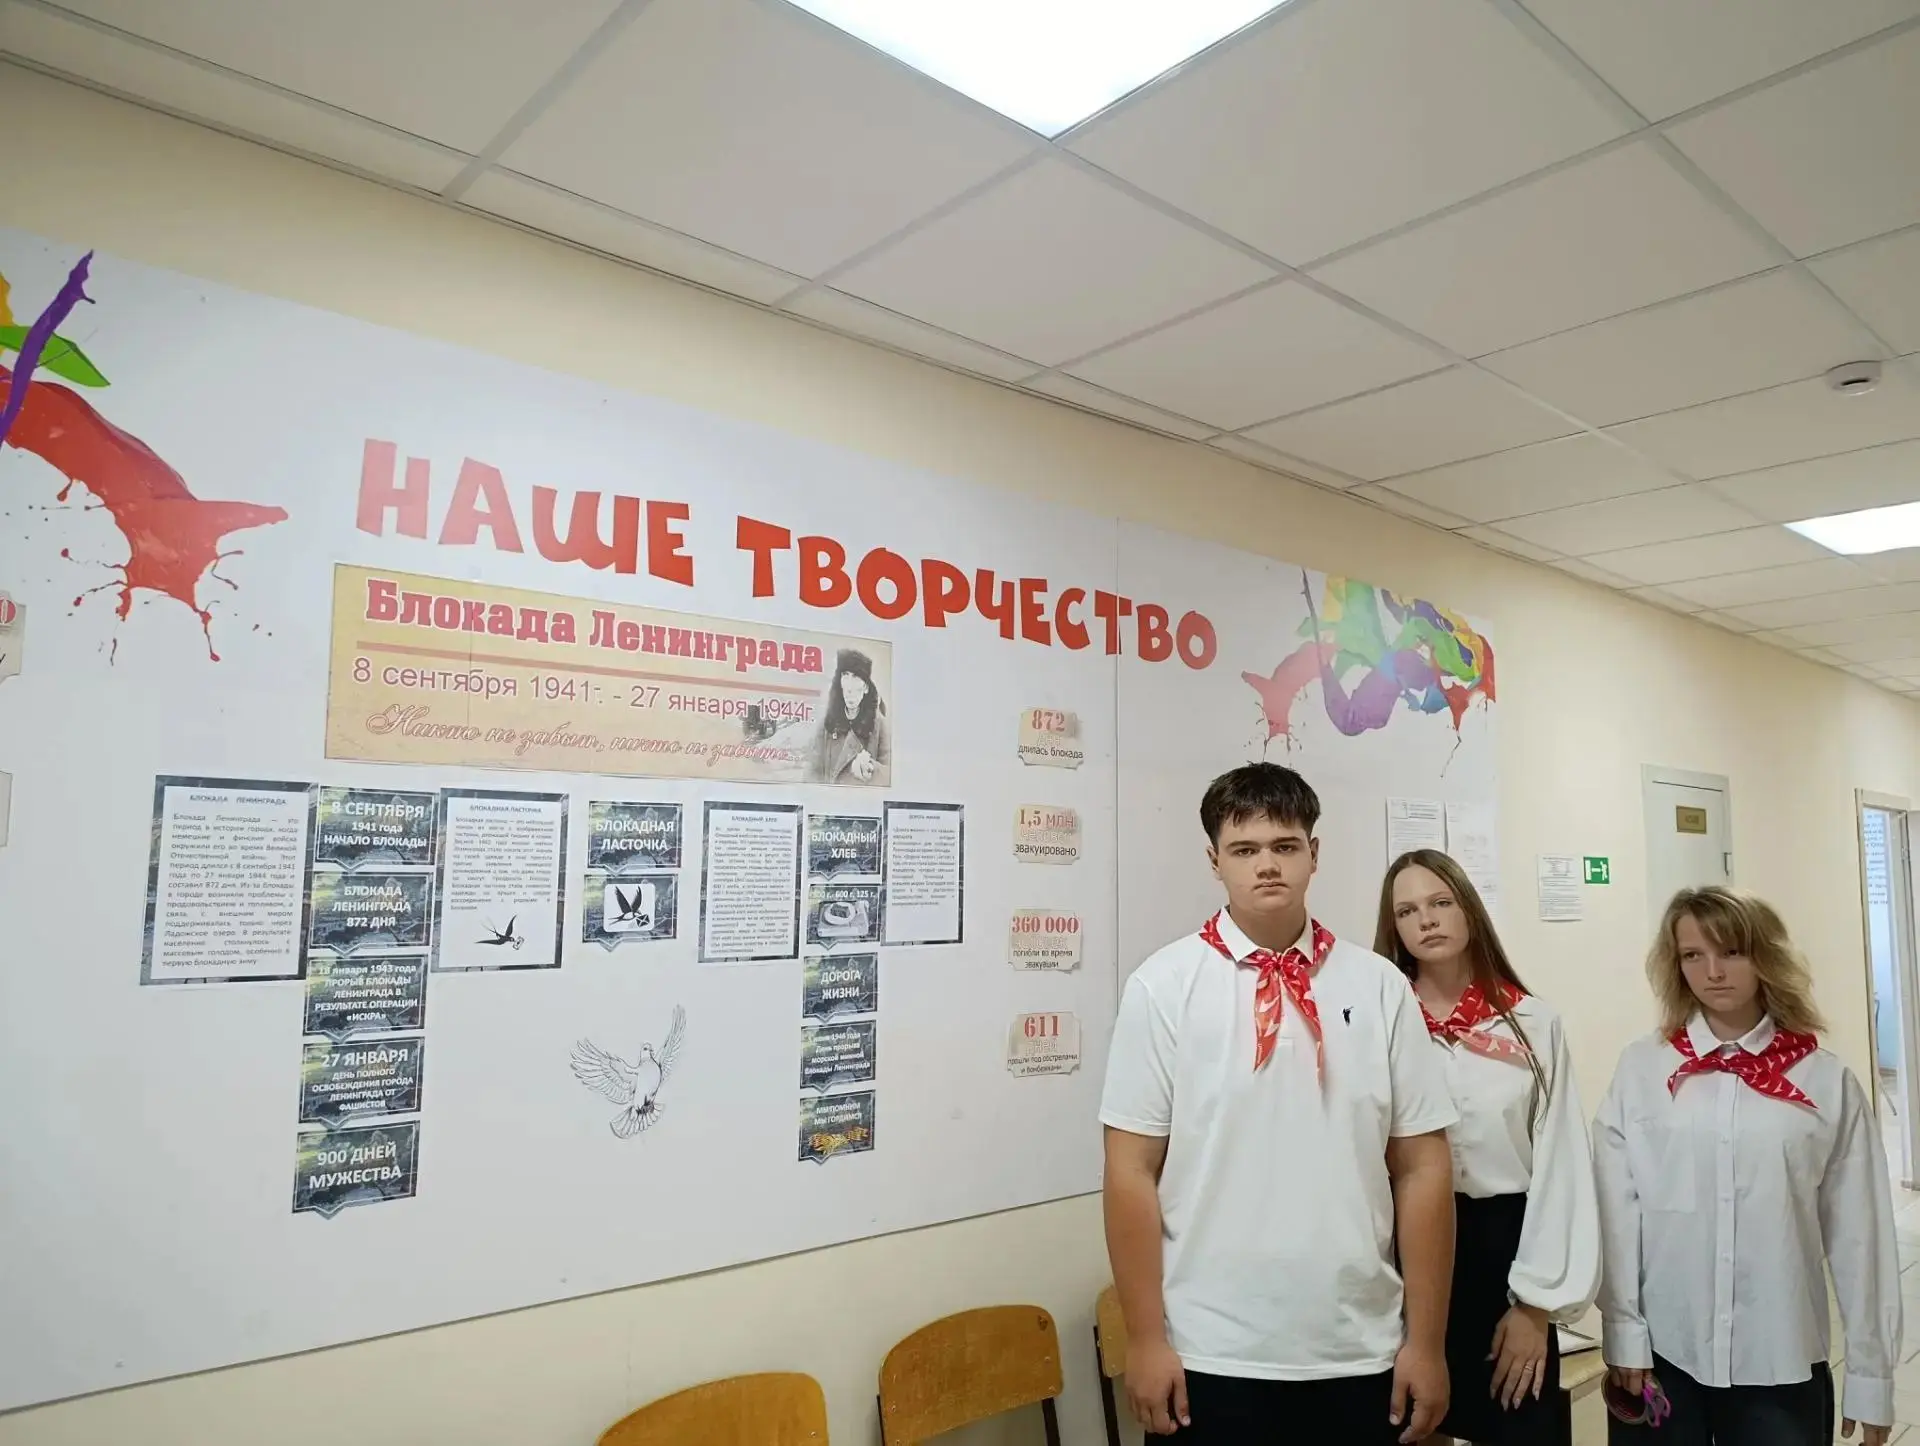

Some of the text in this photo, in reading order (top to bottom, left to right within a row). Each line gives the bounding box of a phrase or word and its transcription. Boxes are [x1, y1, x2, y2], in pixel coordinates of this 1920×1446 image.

[356, 438, 1218, 669] НАШЕ ТВОРЧЕСТВО
[366, 579, 823, 673] Блокада Ленинграда
[353, 657, 371, 682] 8
[383, 666, 517, 699] сентября
[631, 685, 660, 708] 27
[668, 695, 747, 719] января
[759, 697, 815, 722] 1944г.
[1032, 710, 1065, 732] 872
[366, 704, 480, 740] Никто
[484, 726, 516, 743] не
[514, 722, 604, 756] забыт,
[1017, 745, 1084, 759] длилась блокада
[331, 801, 424, 818] 8 СЕНТЯБРЯ
[1020, 809, 1041, 828] 1,5
[352, 821, 403, 833] 1941 года
[596, 819, 674, 833] БЛОКАДНАЯ
[324, 834, 427, 848] НАЧАЛО БЛОКАДЫ
[601, 838, 668, 850] ЛАСТОЧКА
[811, 830, 877, 844] БЛОКАДНЫЙ
[831, 848, 857, 859] ХЛЕБ
[1015, 844, 1077, 857] эвакуировано
[344, 886, 402, 897] БЛОКАДА
[332, 901, 412, 913] ЛЕНИНГРАДА
[346, 916, 396, 929] 872 ДНЯ
[1012, 916, 1079, 934] 360 000
[370, 964, 393, 973] 1943
[395, 965, 417, 973] года
[324, 976, 411, 987] ПРОРЫВ БЛОКАДЫ
[821, 970, 861, 985] ДОРОГА
[333, 988, 401, 999] ЛЕНИНГРАДА В
[822, 987, 859, 1000] ЖИЗНИ
[315, 999, 418, 1011] РЕЗУЛЬТАТЕ ОПЕРАЦИИ
[346, 1012, 386, 1021] «ИСКРА»
[1024, 1015, 1059, 1037] 611
[321, 1048, 409, 1067] 27 ЯНВАРЯ
[332, 1068, 396, 1081] ДЕНЬ ПОЛНОГО
[381, 1077, 414, 1087] ГОРОДА
[329, 1088, 396, 1102] ЛЕНИНГРАДА ОТ
[339, 1100, 386, 1111] ФАШИСТОВ
[318, 1141, 397, 1166] 900 ДНЕЙ
[309, 1165, 402, 1189] МУЖЕСТВА
